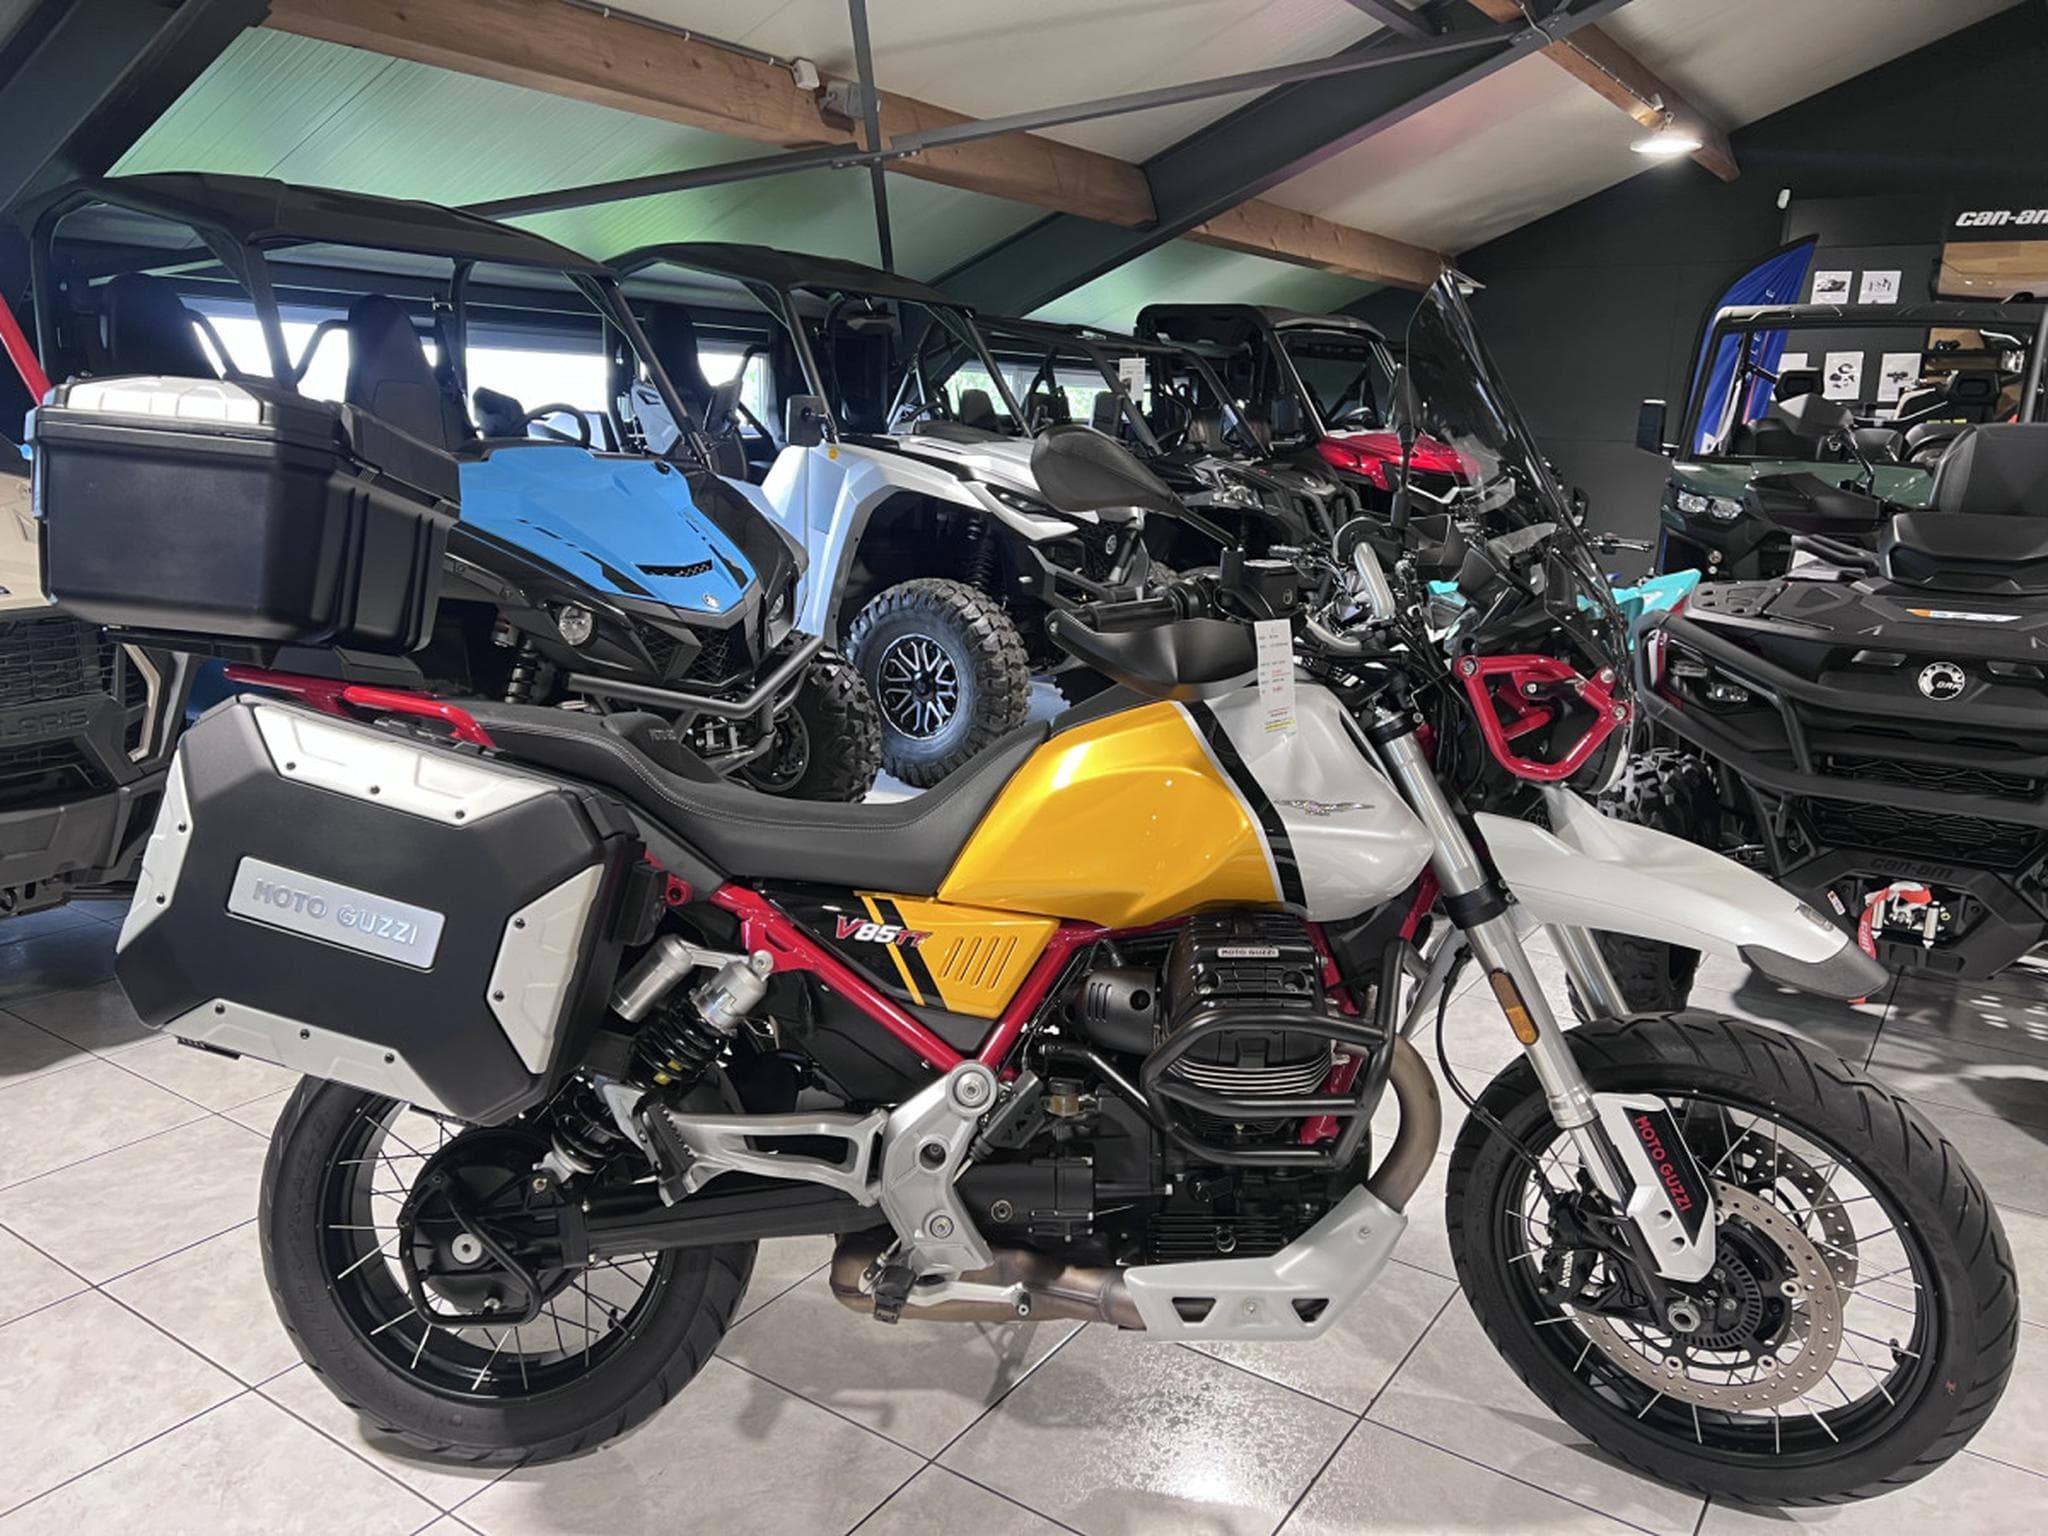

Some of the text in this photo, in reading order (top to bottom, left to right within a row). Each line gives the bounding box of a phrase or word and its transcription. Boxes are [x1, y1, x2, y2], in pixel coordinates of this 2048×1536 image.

[253, 878, 419, 945] MOTO GUZZI
[1635, 1115, 1693, 1212] MOTO GUZZI
